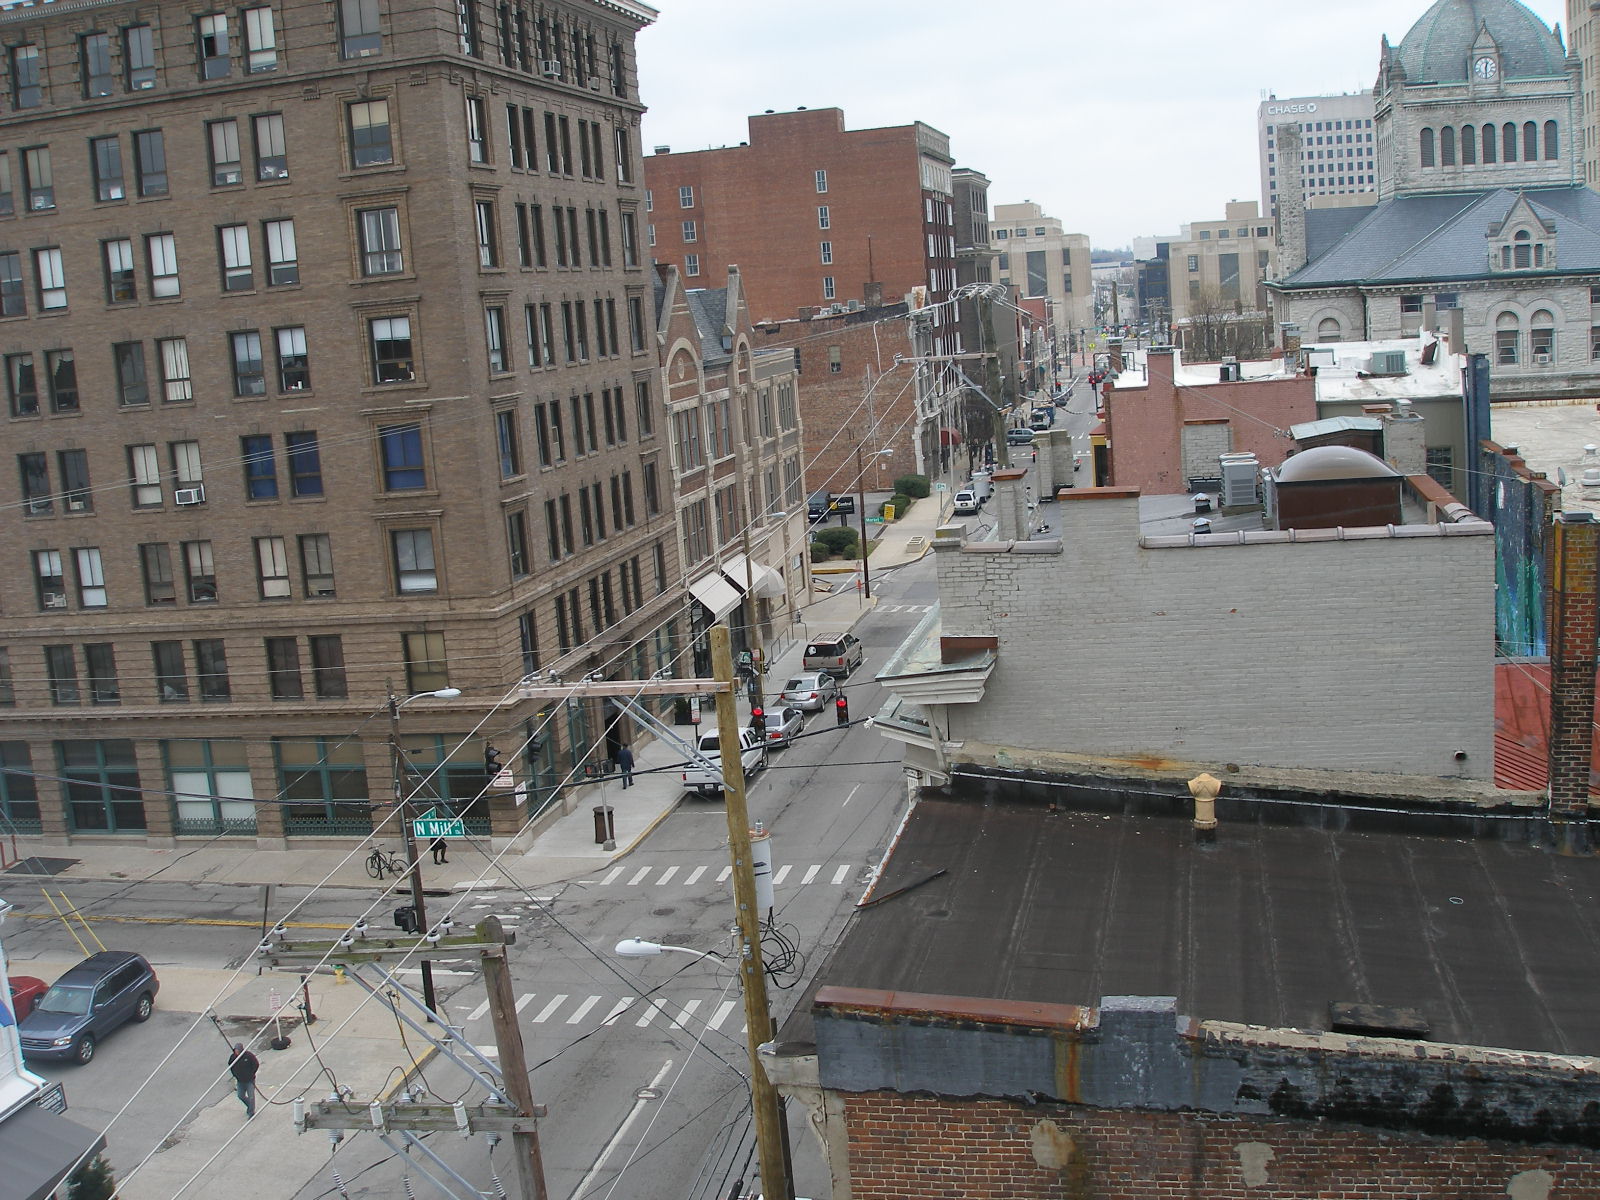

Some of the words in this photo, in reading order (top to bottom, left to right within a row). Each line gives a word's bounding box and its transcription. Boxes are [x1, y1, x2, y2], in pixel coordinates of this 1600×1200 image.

[1268, 104, 1305, 115] CHASE
[416, 822, 425, 835] N
[430, 821, 452, 835] Mill
